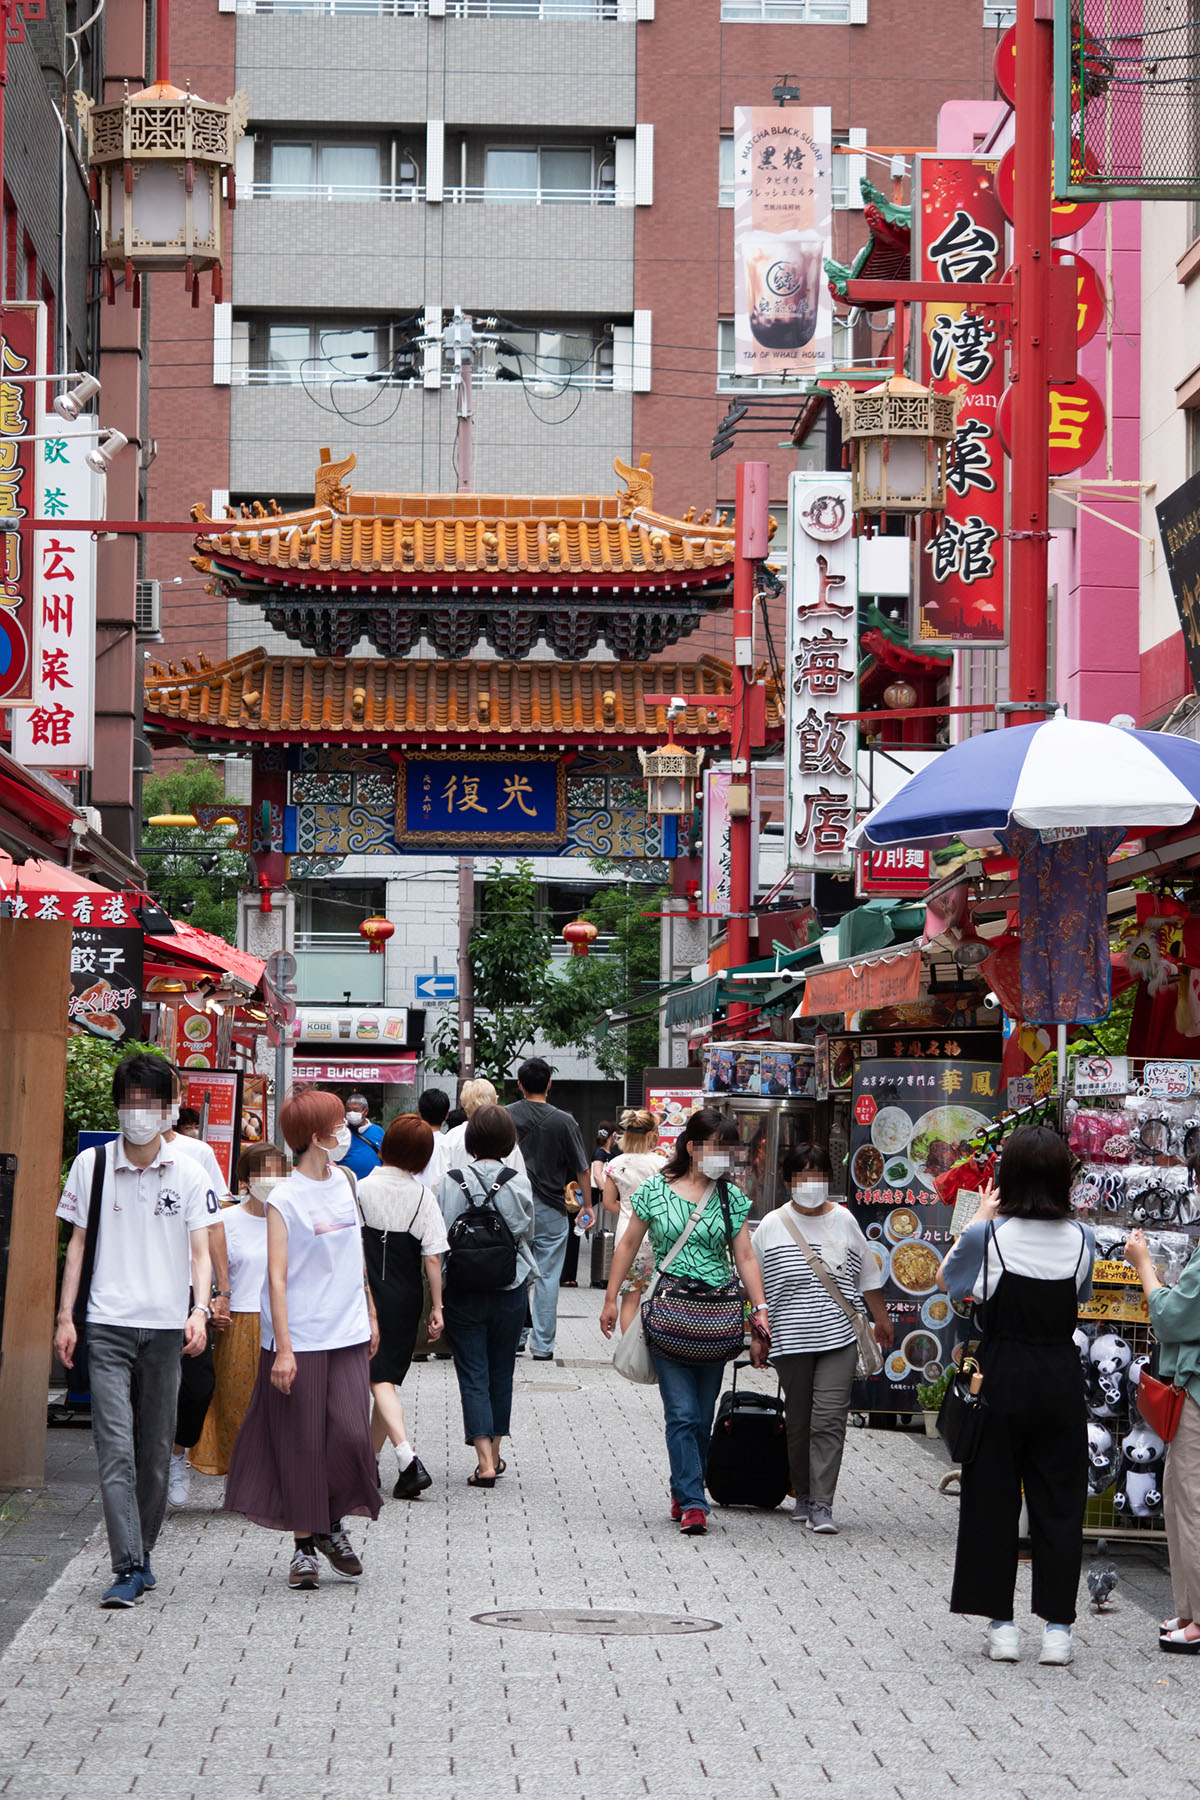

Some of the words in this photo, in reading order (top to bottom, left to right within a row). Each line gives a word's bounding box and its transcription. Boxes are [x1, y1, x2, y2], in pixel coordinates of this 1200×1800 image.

[741, 129, 770, 160] MATCHA
[770, 126, 799, 137] BLACK
[800, 133, 823, 161] SUGAR
[766, 176, 799, 185] タピオカ
[743, 351, 757, 359] TEA
[760, 351, 770, 359] OF
[773, 351, 798, 359] WHALE
[801, 351, 826, 359] HOUSE
[925, 209, 1001, 584] 台湾菜館
[43, 438, 72, 518] 飲茶
[26, 538, 75, 747] 広州菜館
[793, 553, 855, 856] 上海飯店
[70, 946, 126, 974] 餃子
[307, 1023, 332, 1031] KOBE
[292, 1067, 322, 1077] BEEF
[327, 1067, 380, 1079] BURGER
[1167, 1082, 1186, 1094] 550
[855, 1189, 940, 1205] 中華風焼き鳥セッ
